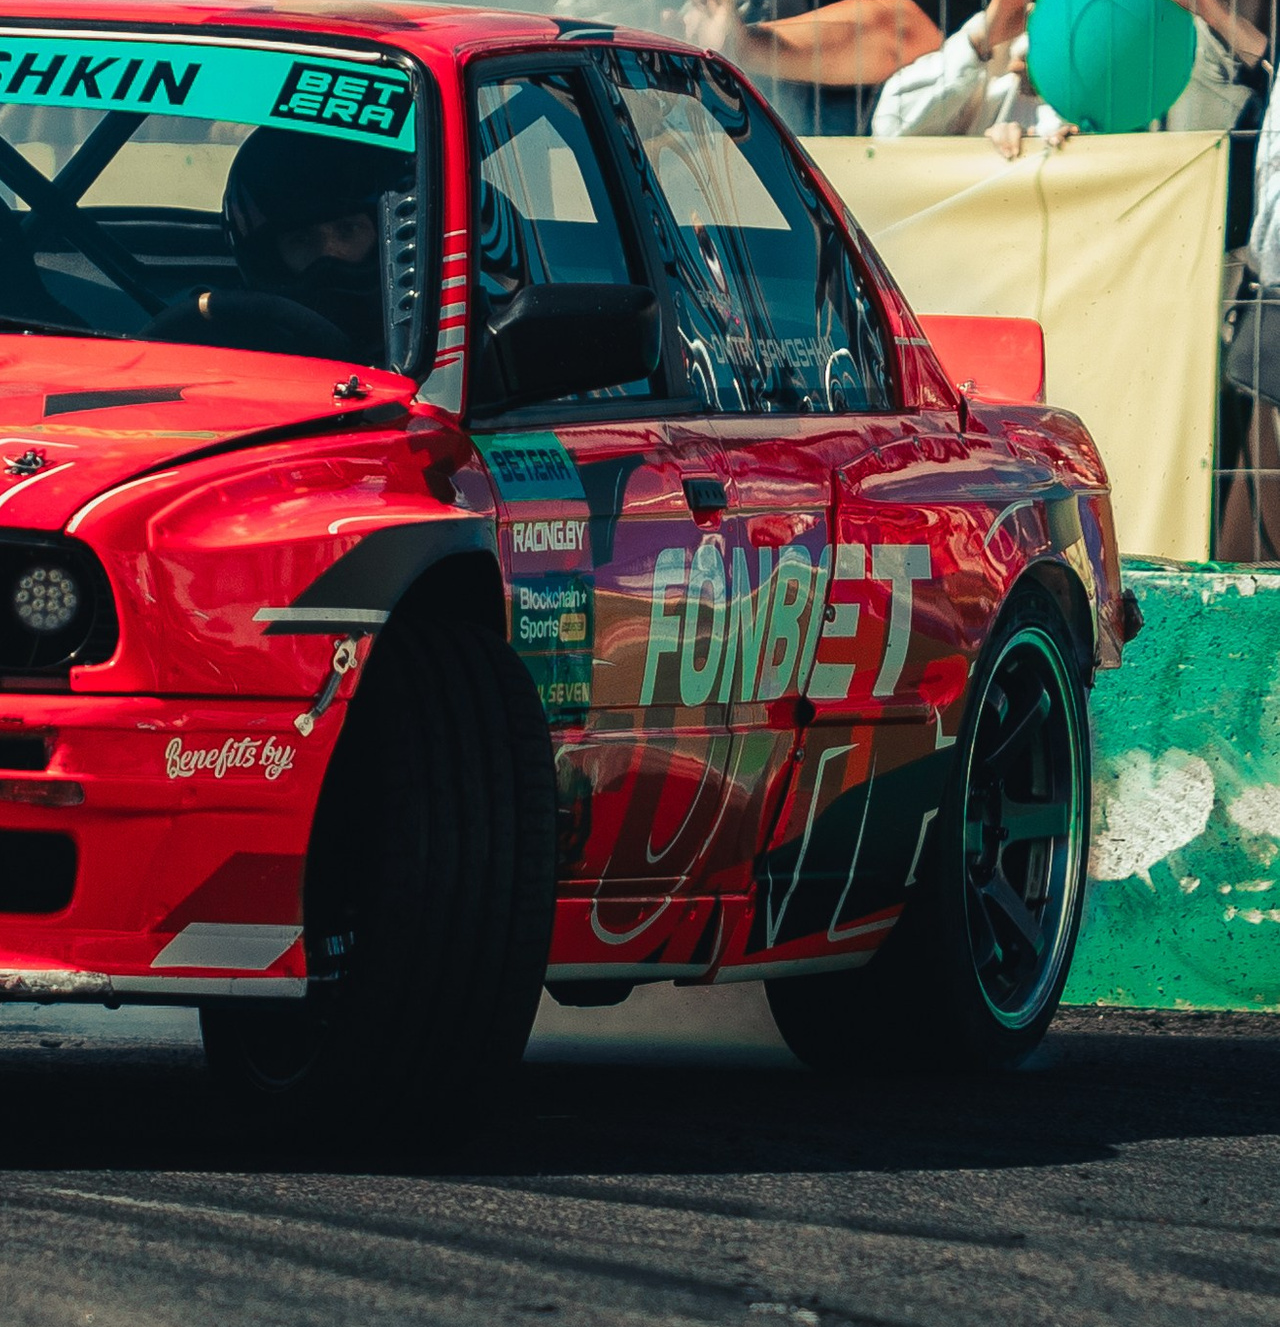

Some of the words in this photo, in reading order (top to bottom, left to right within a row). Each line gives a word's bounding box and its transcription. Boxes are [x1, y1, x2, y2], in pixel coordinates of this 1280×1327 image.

[296, 69, 405, 106] BET
[520, 585, 580, 611] Blockchain
[520, 615, 559, 644] Sports
[638, 542, 932, 707] FONBET
[165, 737, 262, 779] Benefits
[259, 735, 296, 780] by
